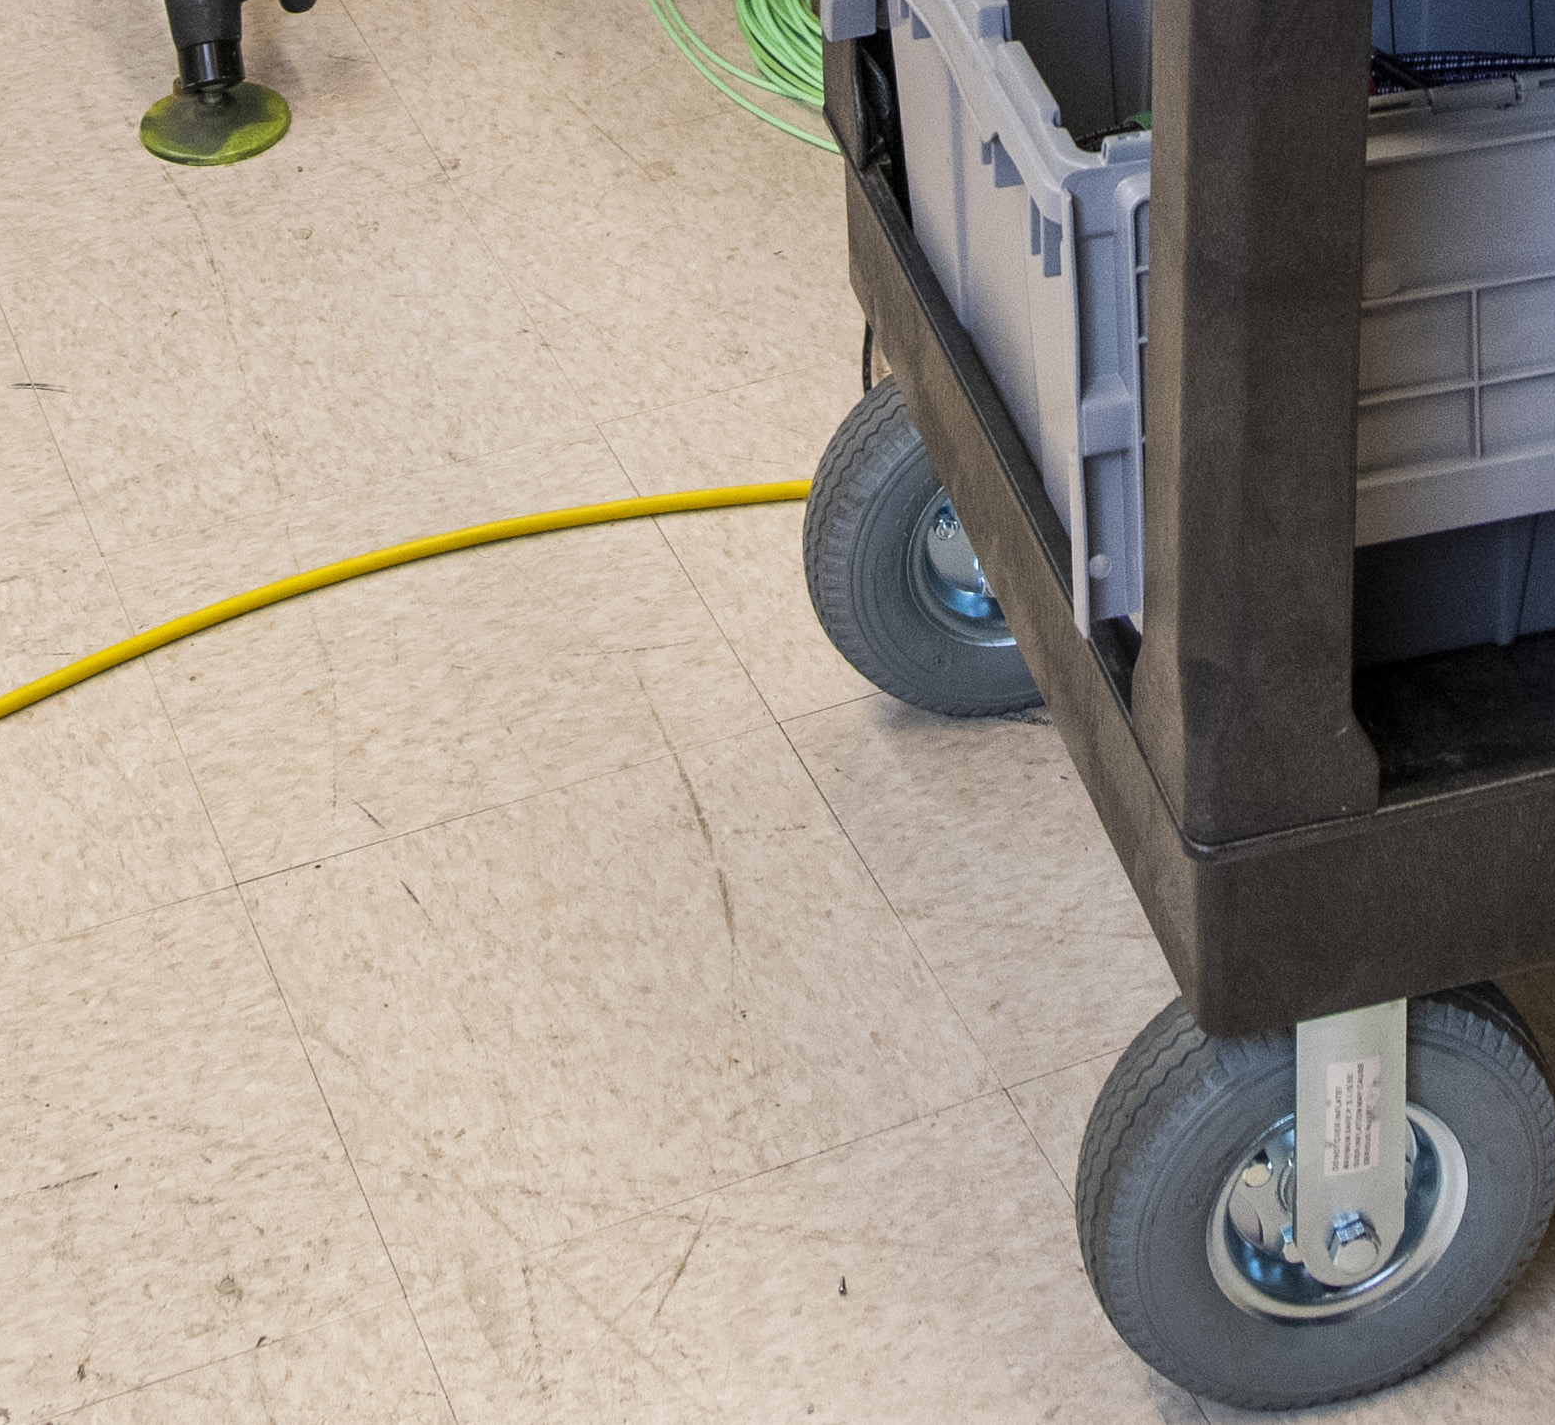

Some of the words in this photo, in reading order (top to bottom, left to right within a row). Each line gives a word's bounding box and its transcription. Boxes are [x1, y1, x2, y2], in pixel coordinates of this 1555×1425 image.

[1356, 1063, 1365, 1088] CAUSE
[1354, 1108, 1363, 1148] INFLATION
[1353, 1149, 1361, 1169] OVER
